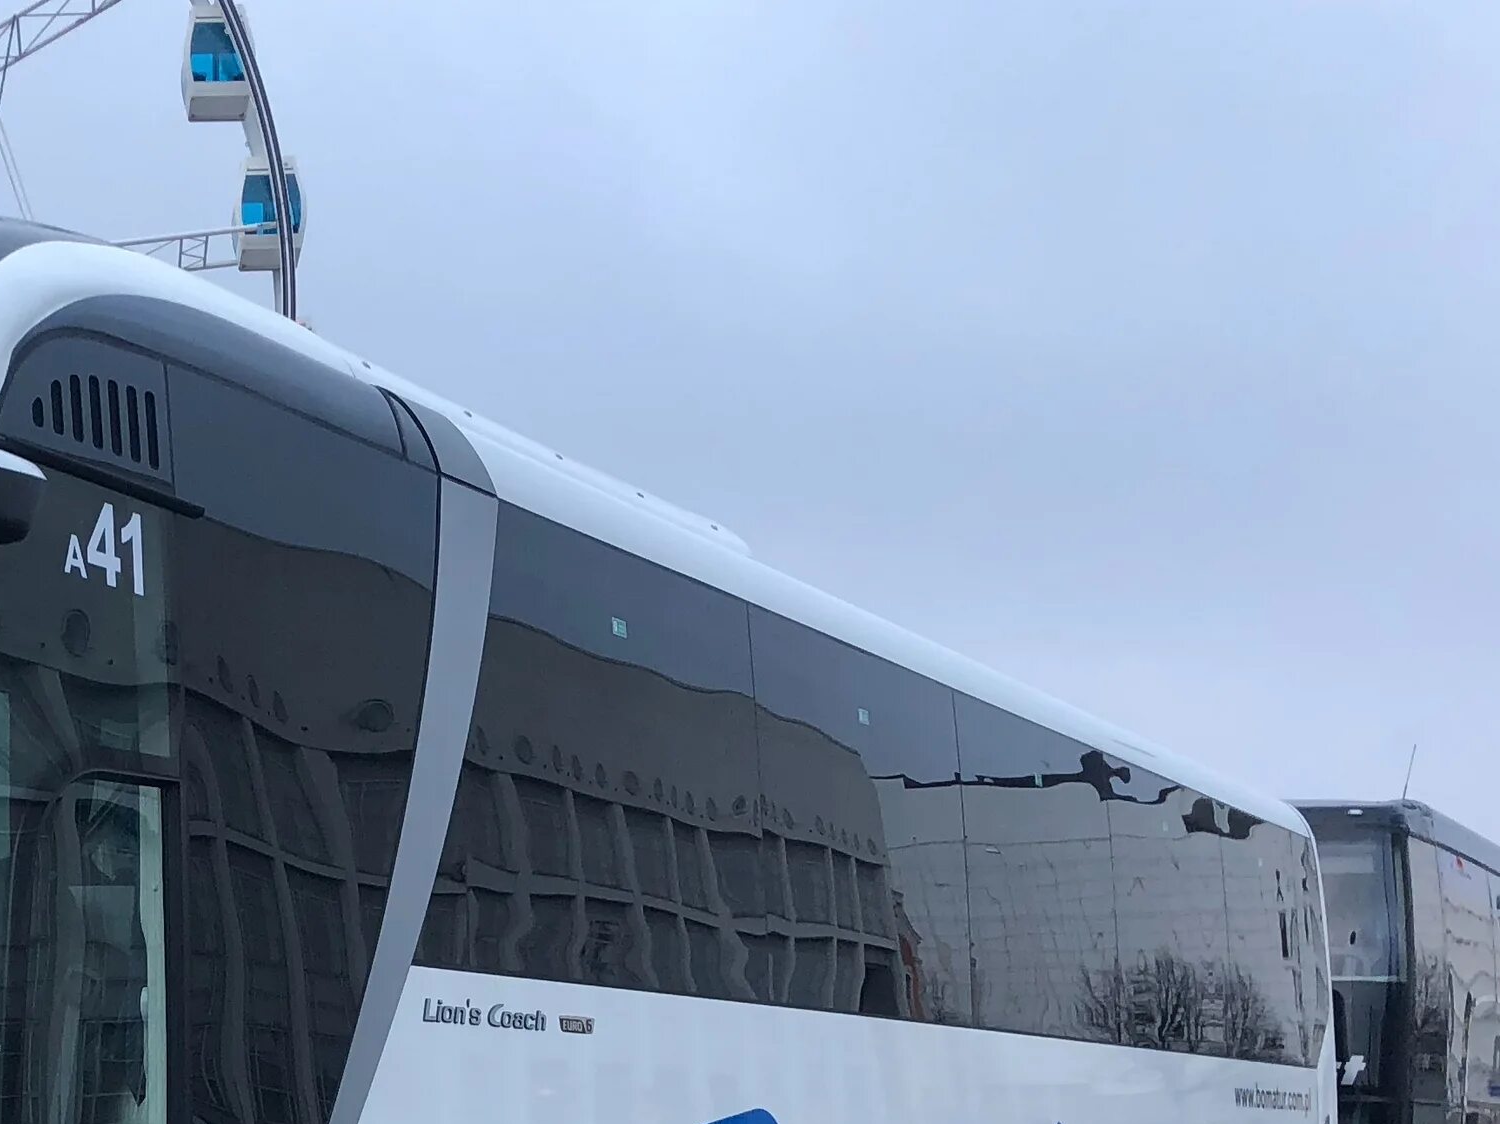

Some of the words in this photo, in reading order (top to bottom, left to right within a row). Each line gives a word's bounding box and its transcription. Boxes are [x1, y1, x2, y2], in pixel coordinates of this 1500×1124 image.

[422, 998, 482, 1026] Lion's
[487, 1003, 547, 1032] Coach
[562, 1019, 583, 1032] EURO
[1234, 1081, 1312, 1118] www.bomatur.com.pl
